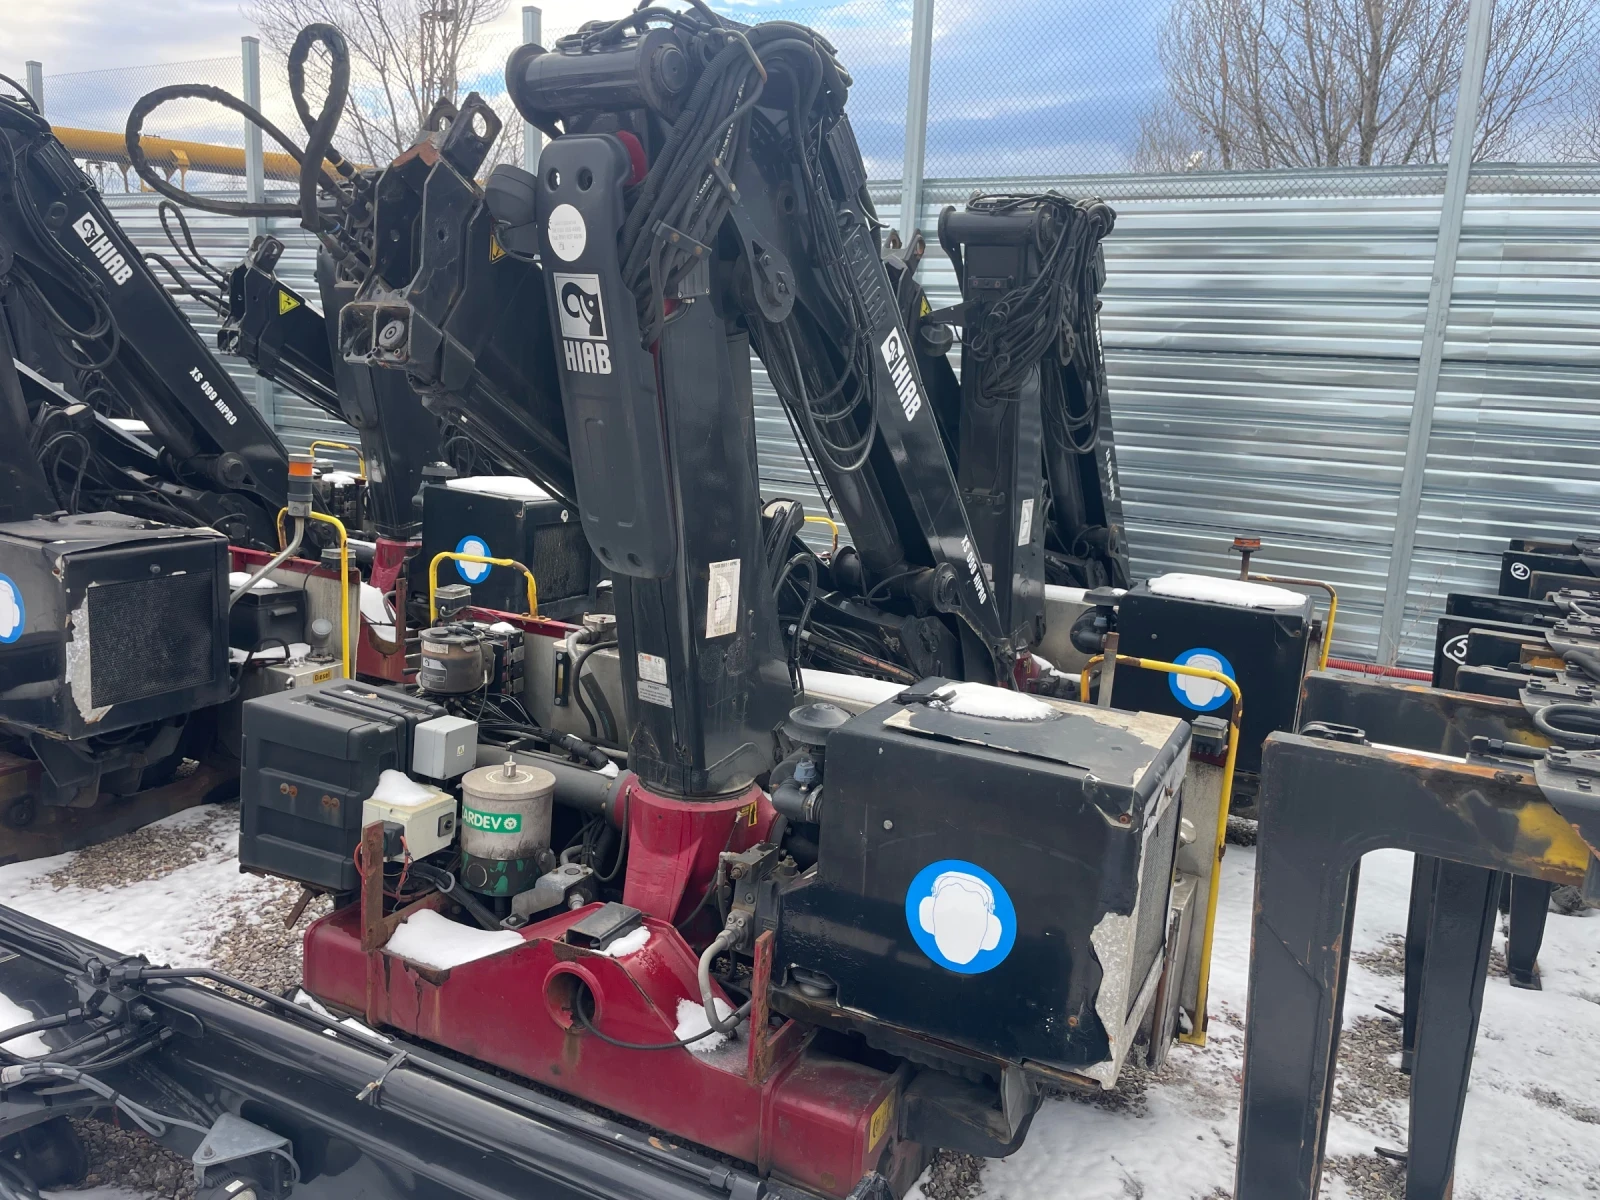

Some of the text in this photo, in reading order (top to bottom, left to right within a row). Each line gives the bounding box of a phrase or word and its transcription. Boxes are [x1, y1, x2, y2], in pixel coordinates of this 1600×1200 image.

[90, 235, 133, 286] HIAB
[563, 340, 612, 374] HIAB
[189, 366, 237, 425] XS 099 HIPRO
[892, 357, 921, 422] HIAB
[961, 534, 970, 552] XS
[973, 571, 987, 605] HIPRO
